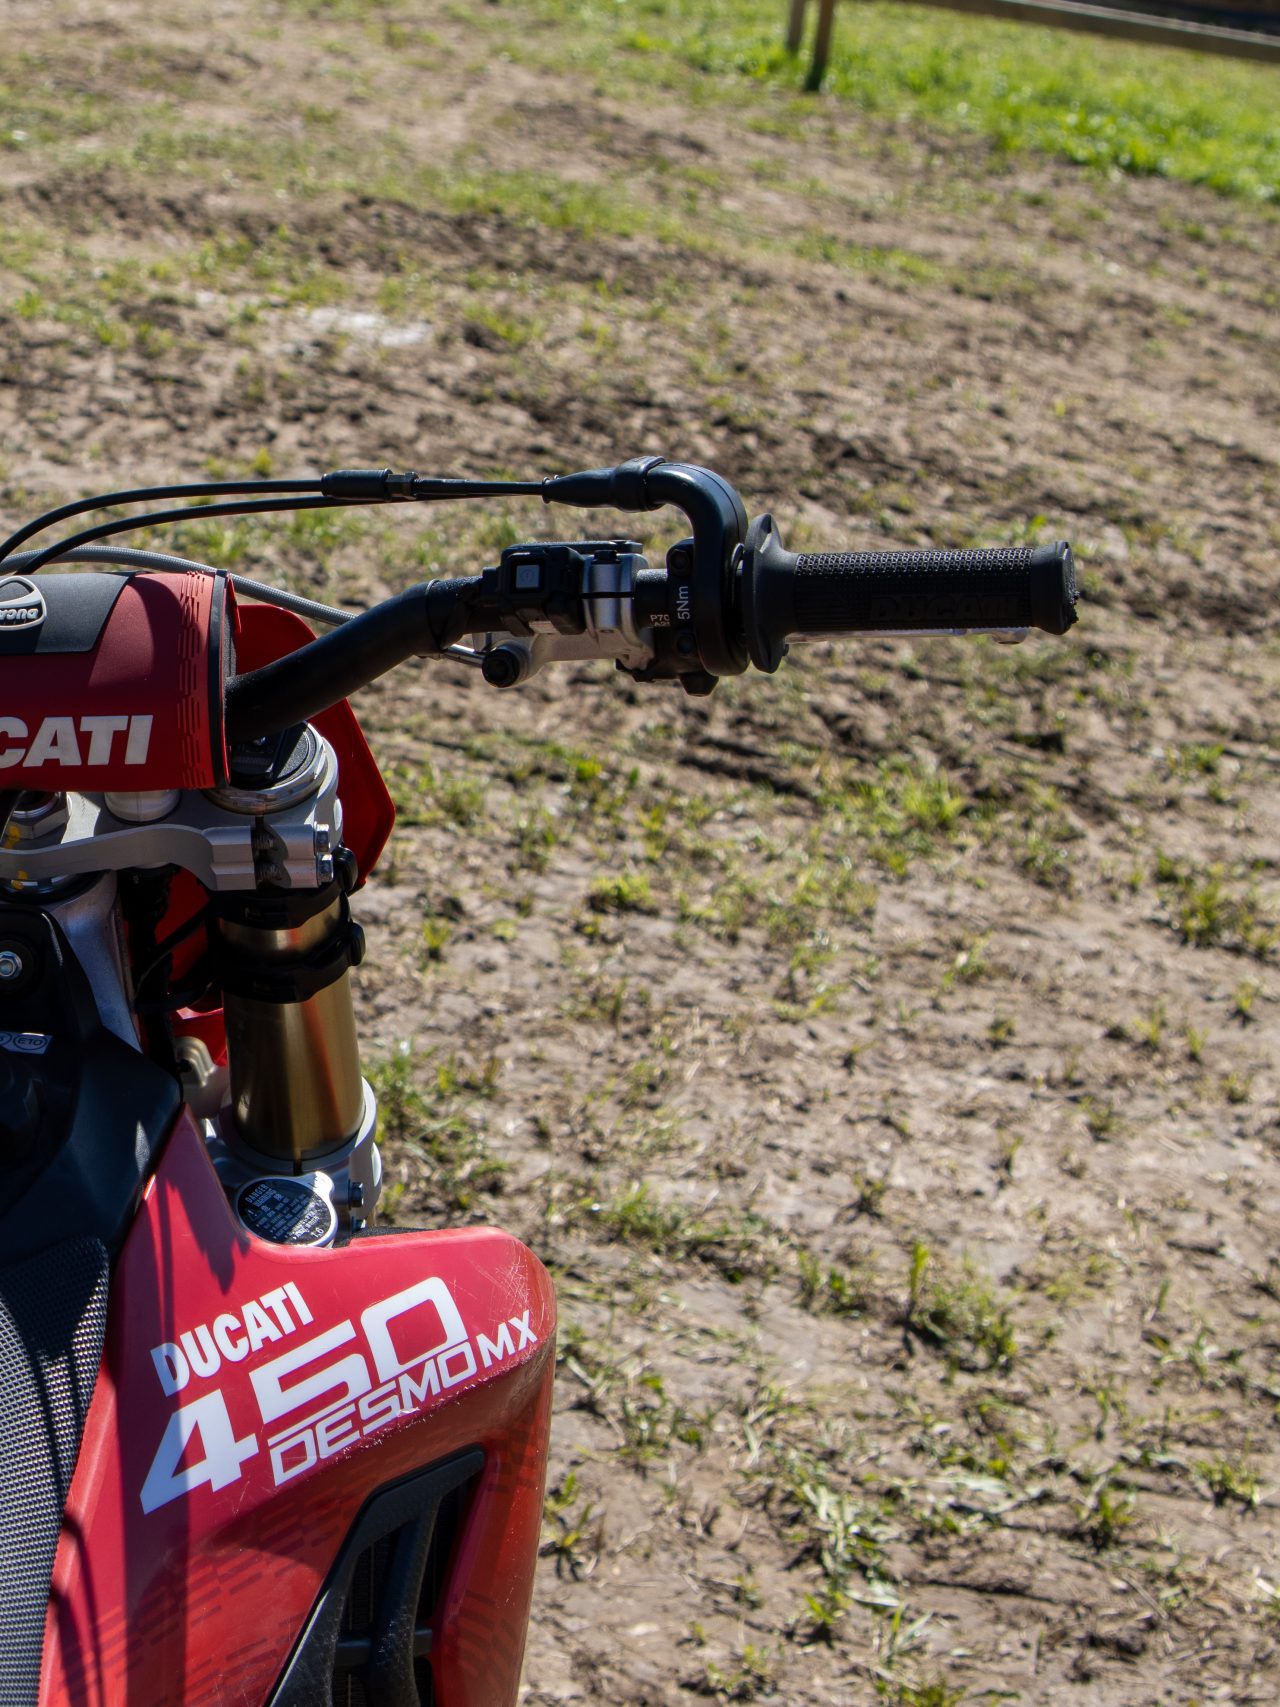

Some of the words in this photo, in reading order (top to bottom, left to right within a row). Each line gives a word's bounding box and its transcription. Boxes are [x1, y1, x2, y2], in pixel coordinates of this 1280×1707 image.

[676, 585, 691, 620] 5Nm
[140, 1276, 468, 1515] 450
[150, 1282, 314, 1397] DUCATI
[269, 1341, 477, 1487] DESMO
[476, 1311, 538, 1369] MX
